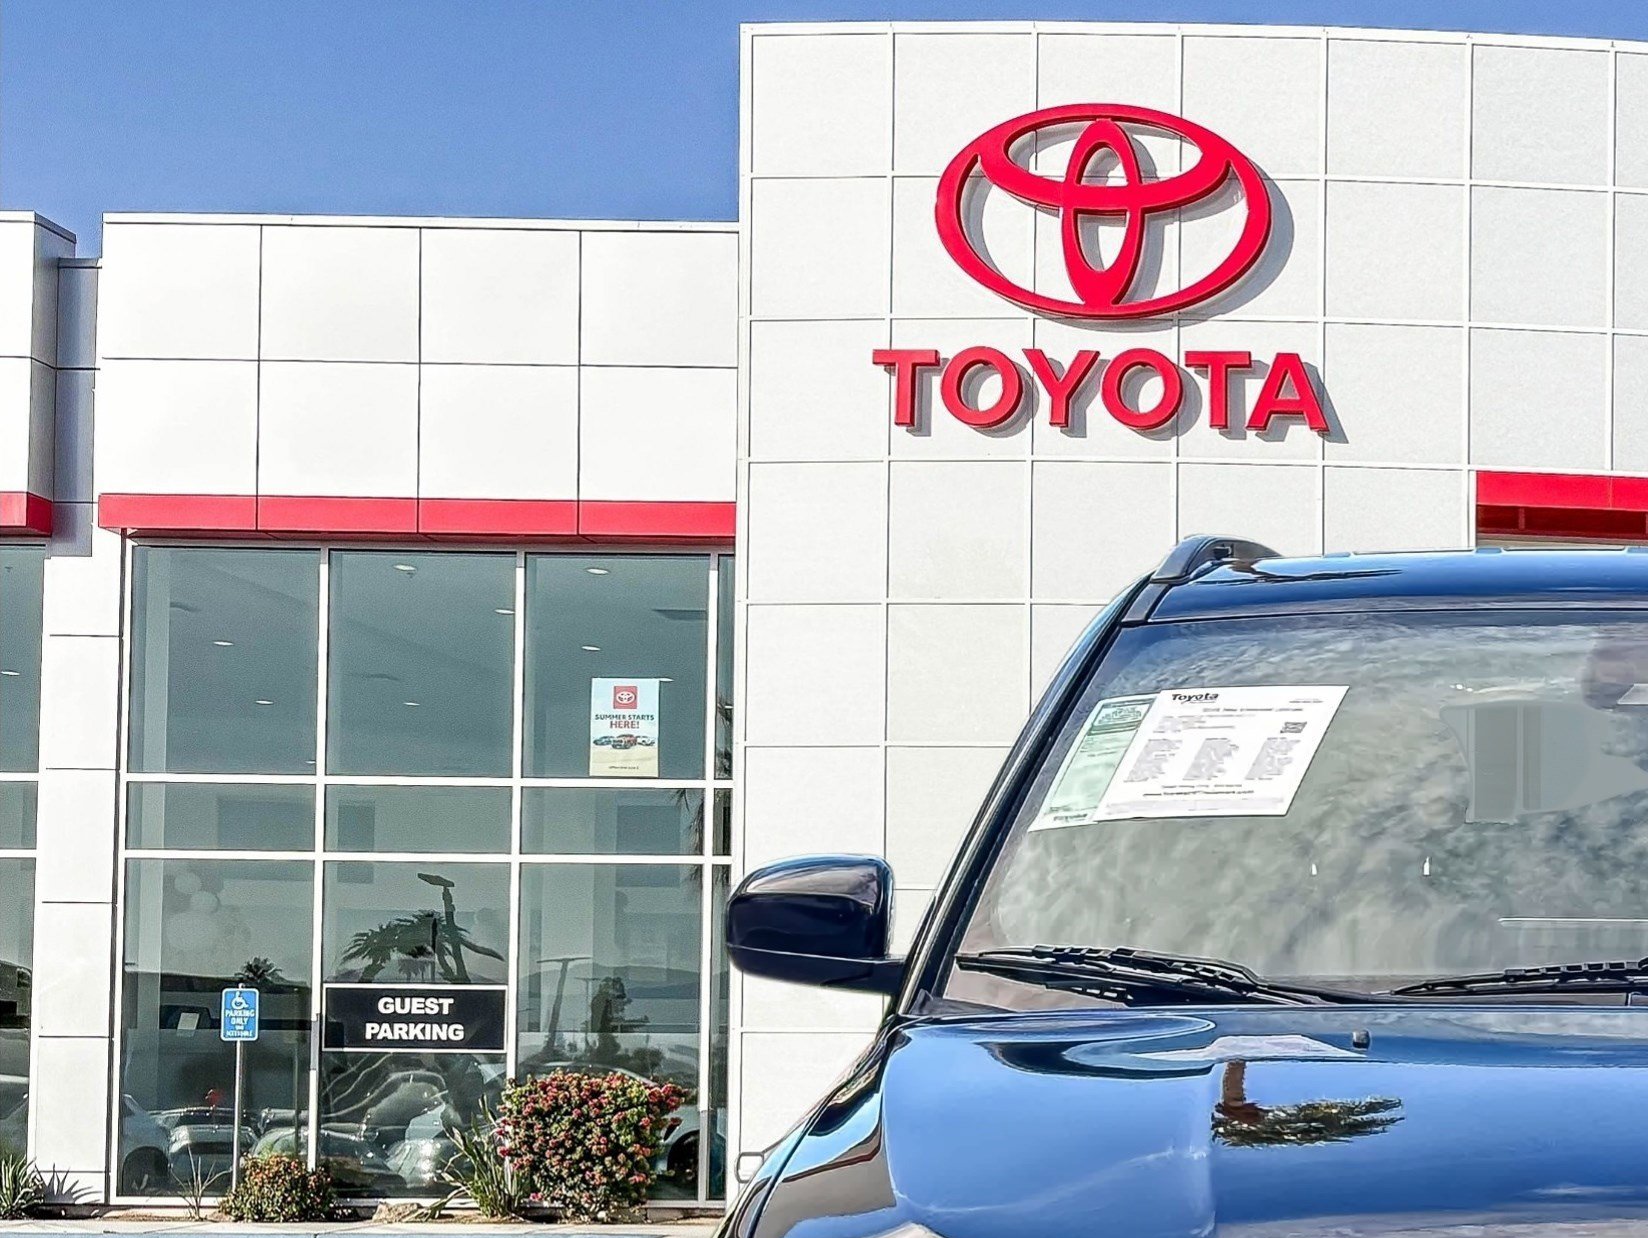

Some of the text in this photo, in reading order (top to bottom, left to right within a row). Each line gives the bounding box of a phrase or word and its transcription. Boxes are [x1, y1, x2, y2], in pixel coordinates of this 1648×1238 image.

[872, 346, 1331, 434] TOYOTA
[609, 720, 640, 729] HERE!
[378, 997, 454, 1015] GUEST
[225, 1009, 255, 1017] PARKING
[230, 1017, 250, 1025] ONLY
[365, 1023, 465, 1041] PARKING
